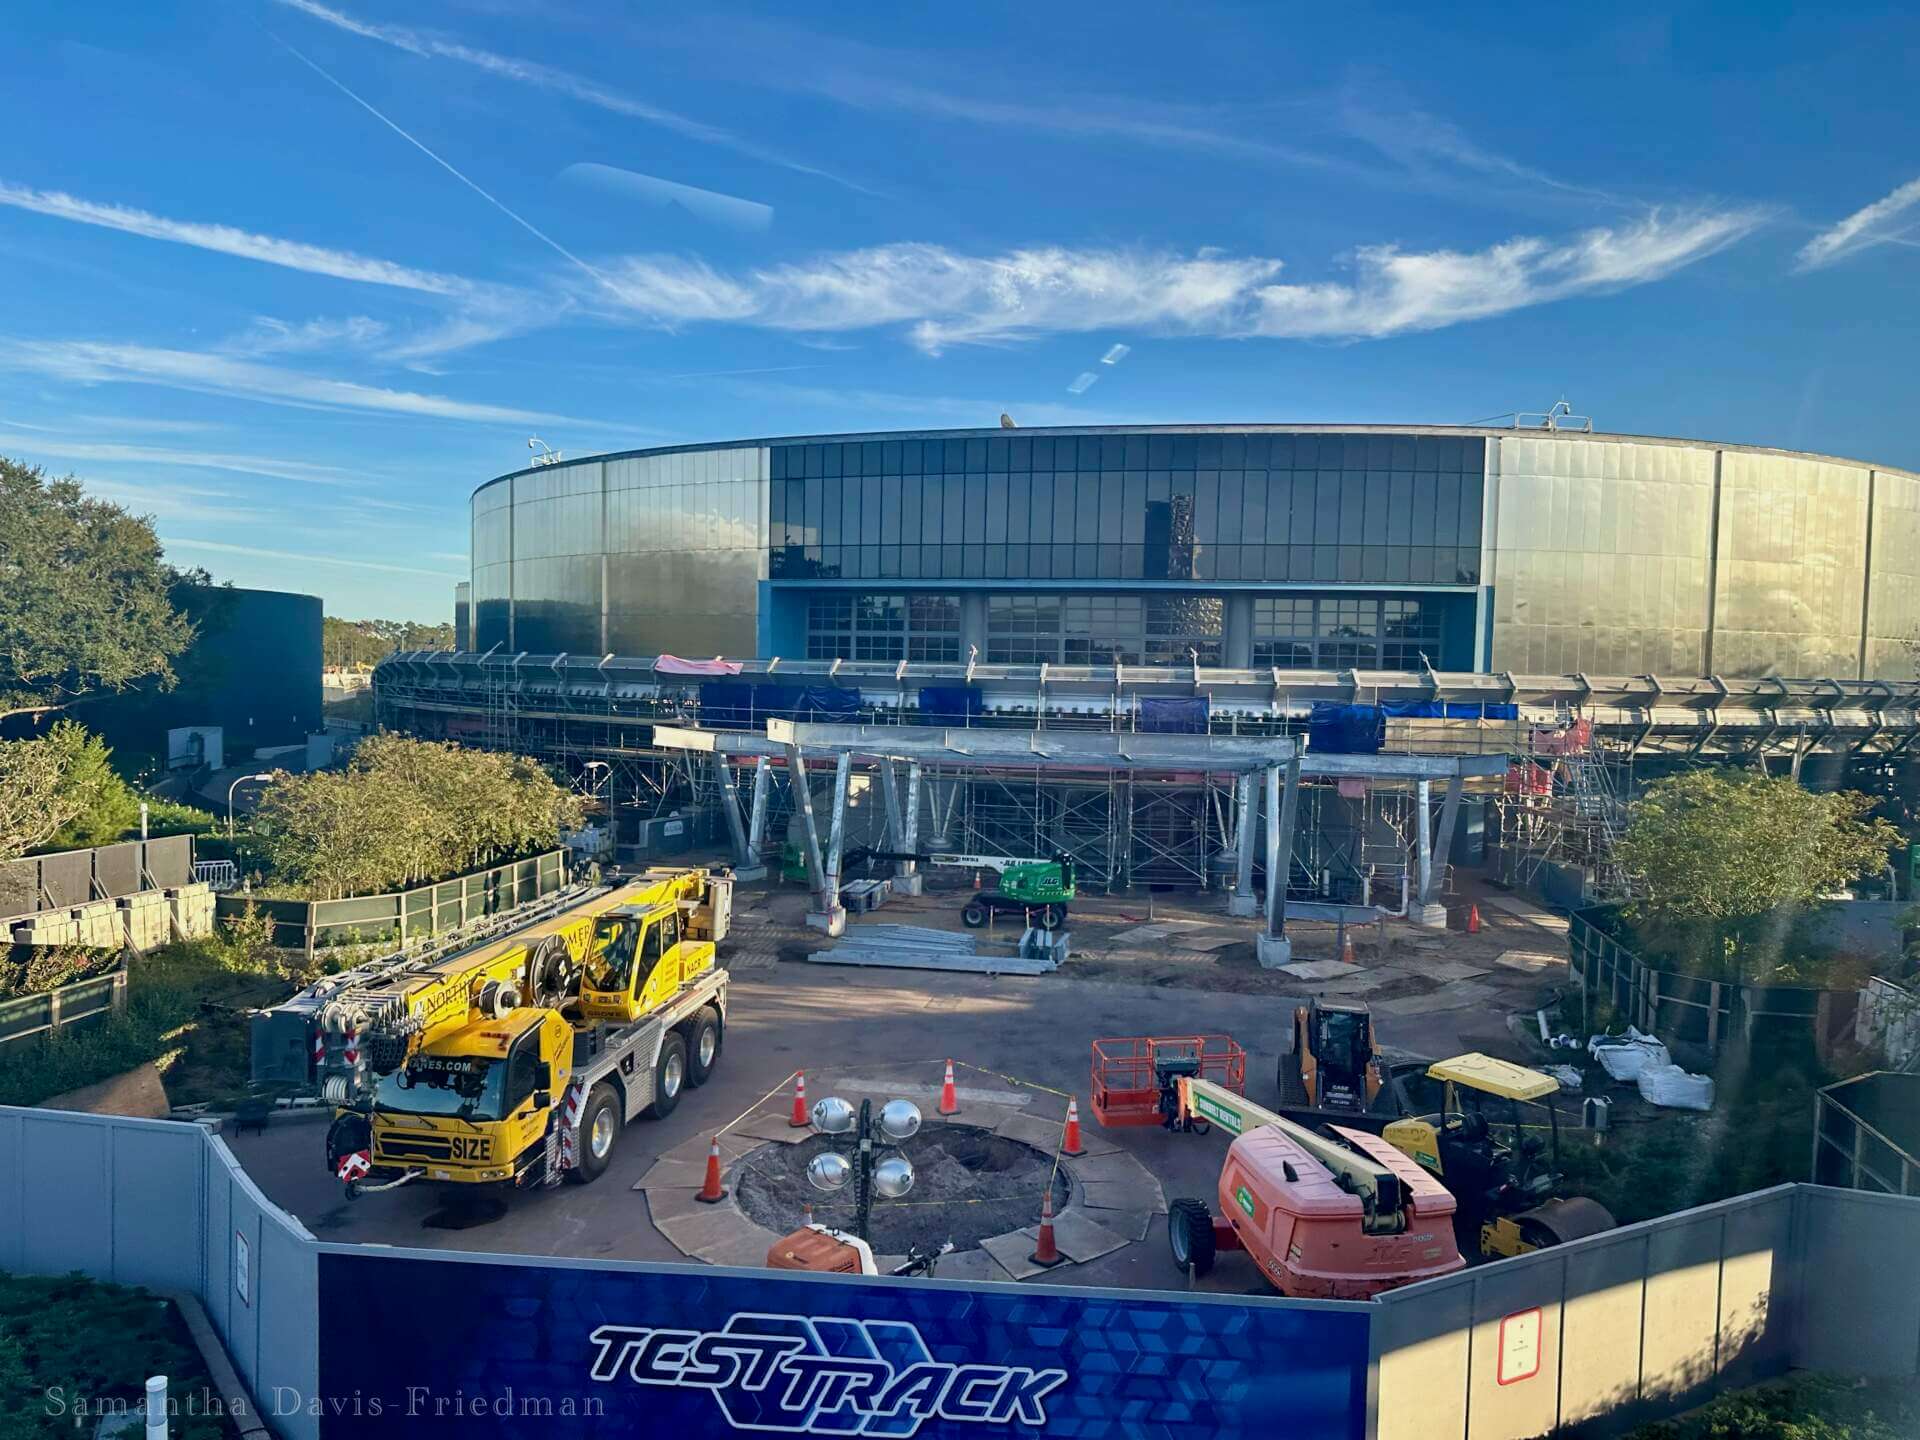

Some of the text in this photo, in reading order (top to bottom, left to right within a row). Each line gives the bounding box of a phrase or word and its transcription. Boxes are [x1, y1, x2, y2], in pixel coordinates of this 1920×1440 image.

[452, 1136, 490, 1161] SIZE
[590, 1325, 806, 1390] TEST
[778, 1356, 1068, 1425] TRACK
